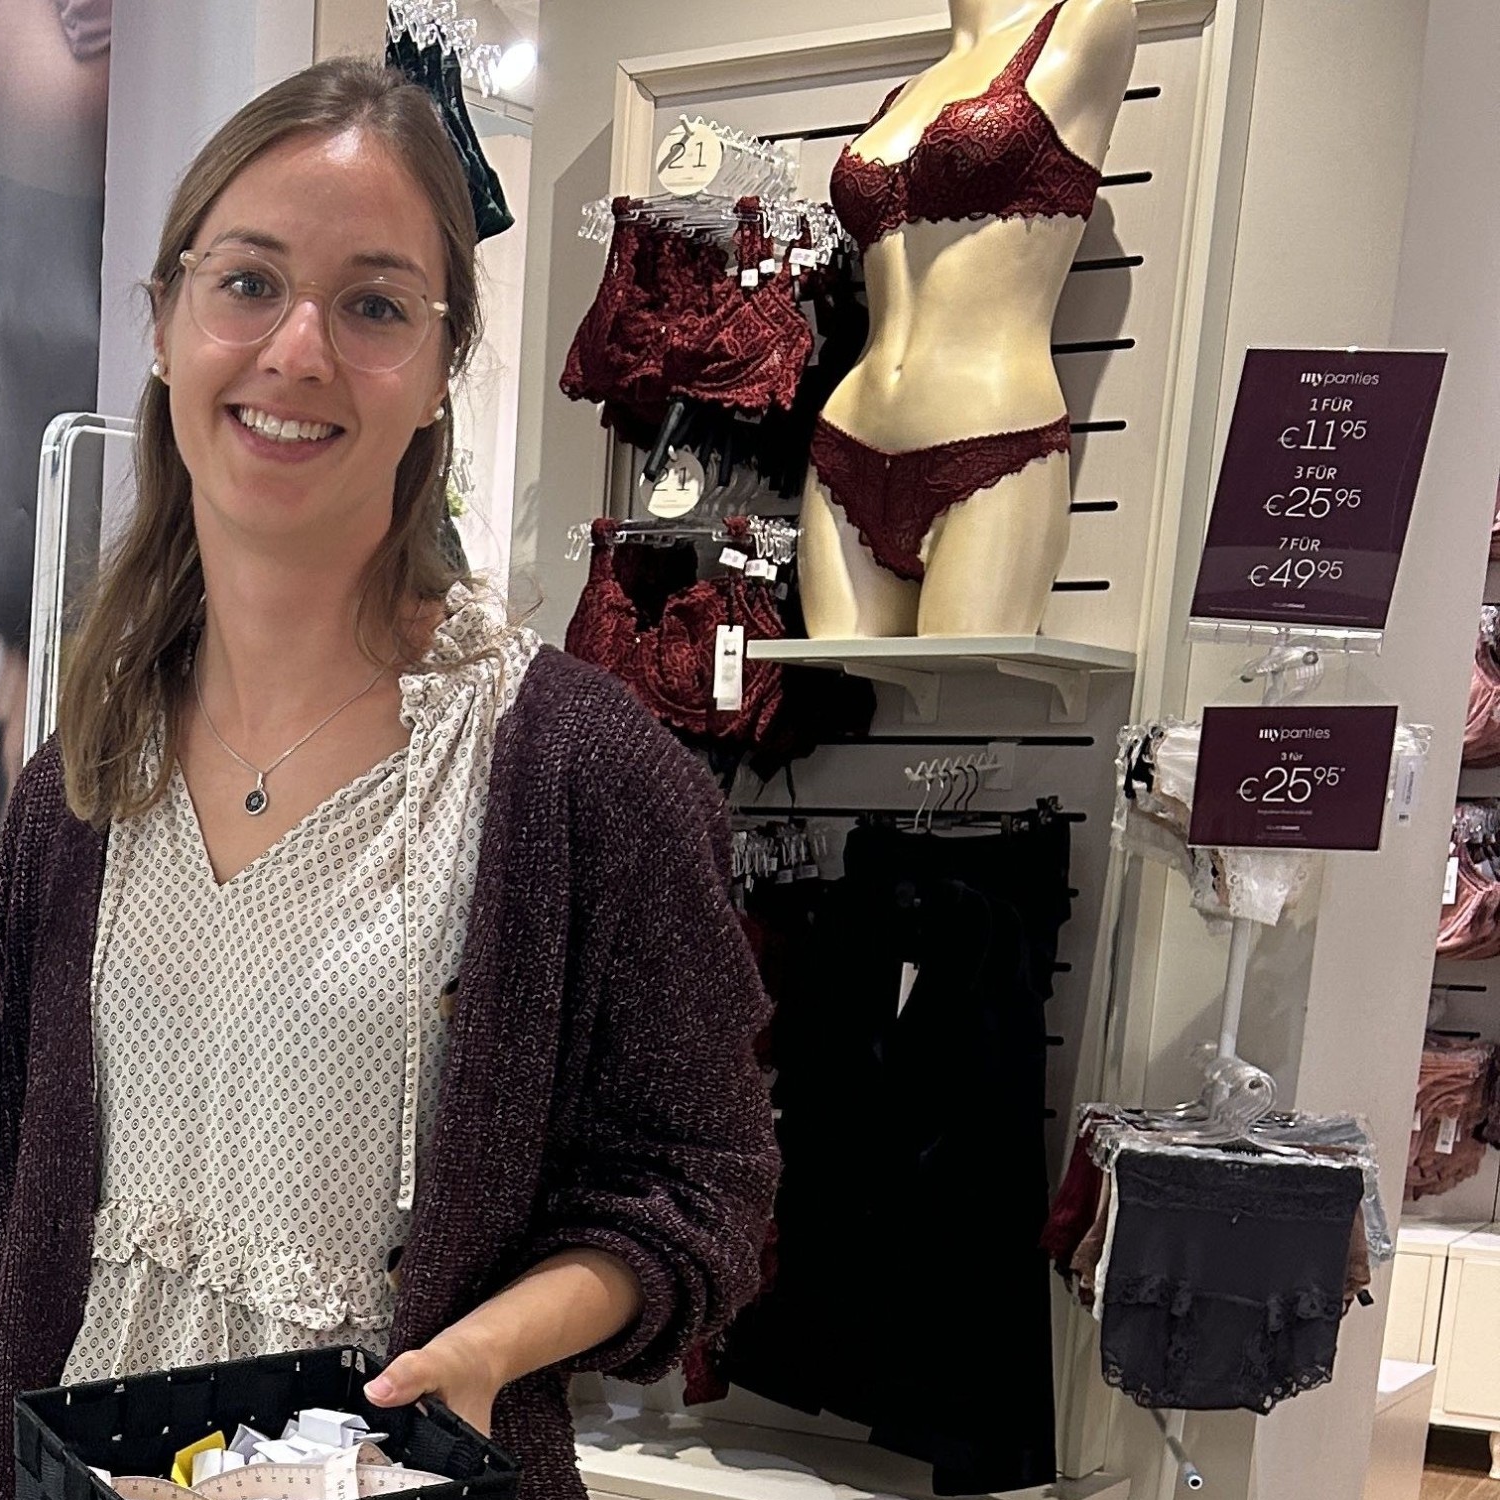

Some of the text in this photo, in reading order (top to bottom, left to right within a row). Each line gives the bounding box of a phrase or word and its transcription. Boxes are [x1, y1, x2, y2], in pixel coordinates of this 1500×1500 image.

[1309, 397, 1353, 412] 1 FÜR
[1294, 464, 1338, 480] 3 FÜR
[1279, 536, 1321, 552] 7 FÜR
[1280, 751, 1303, 761] 3 für
